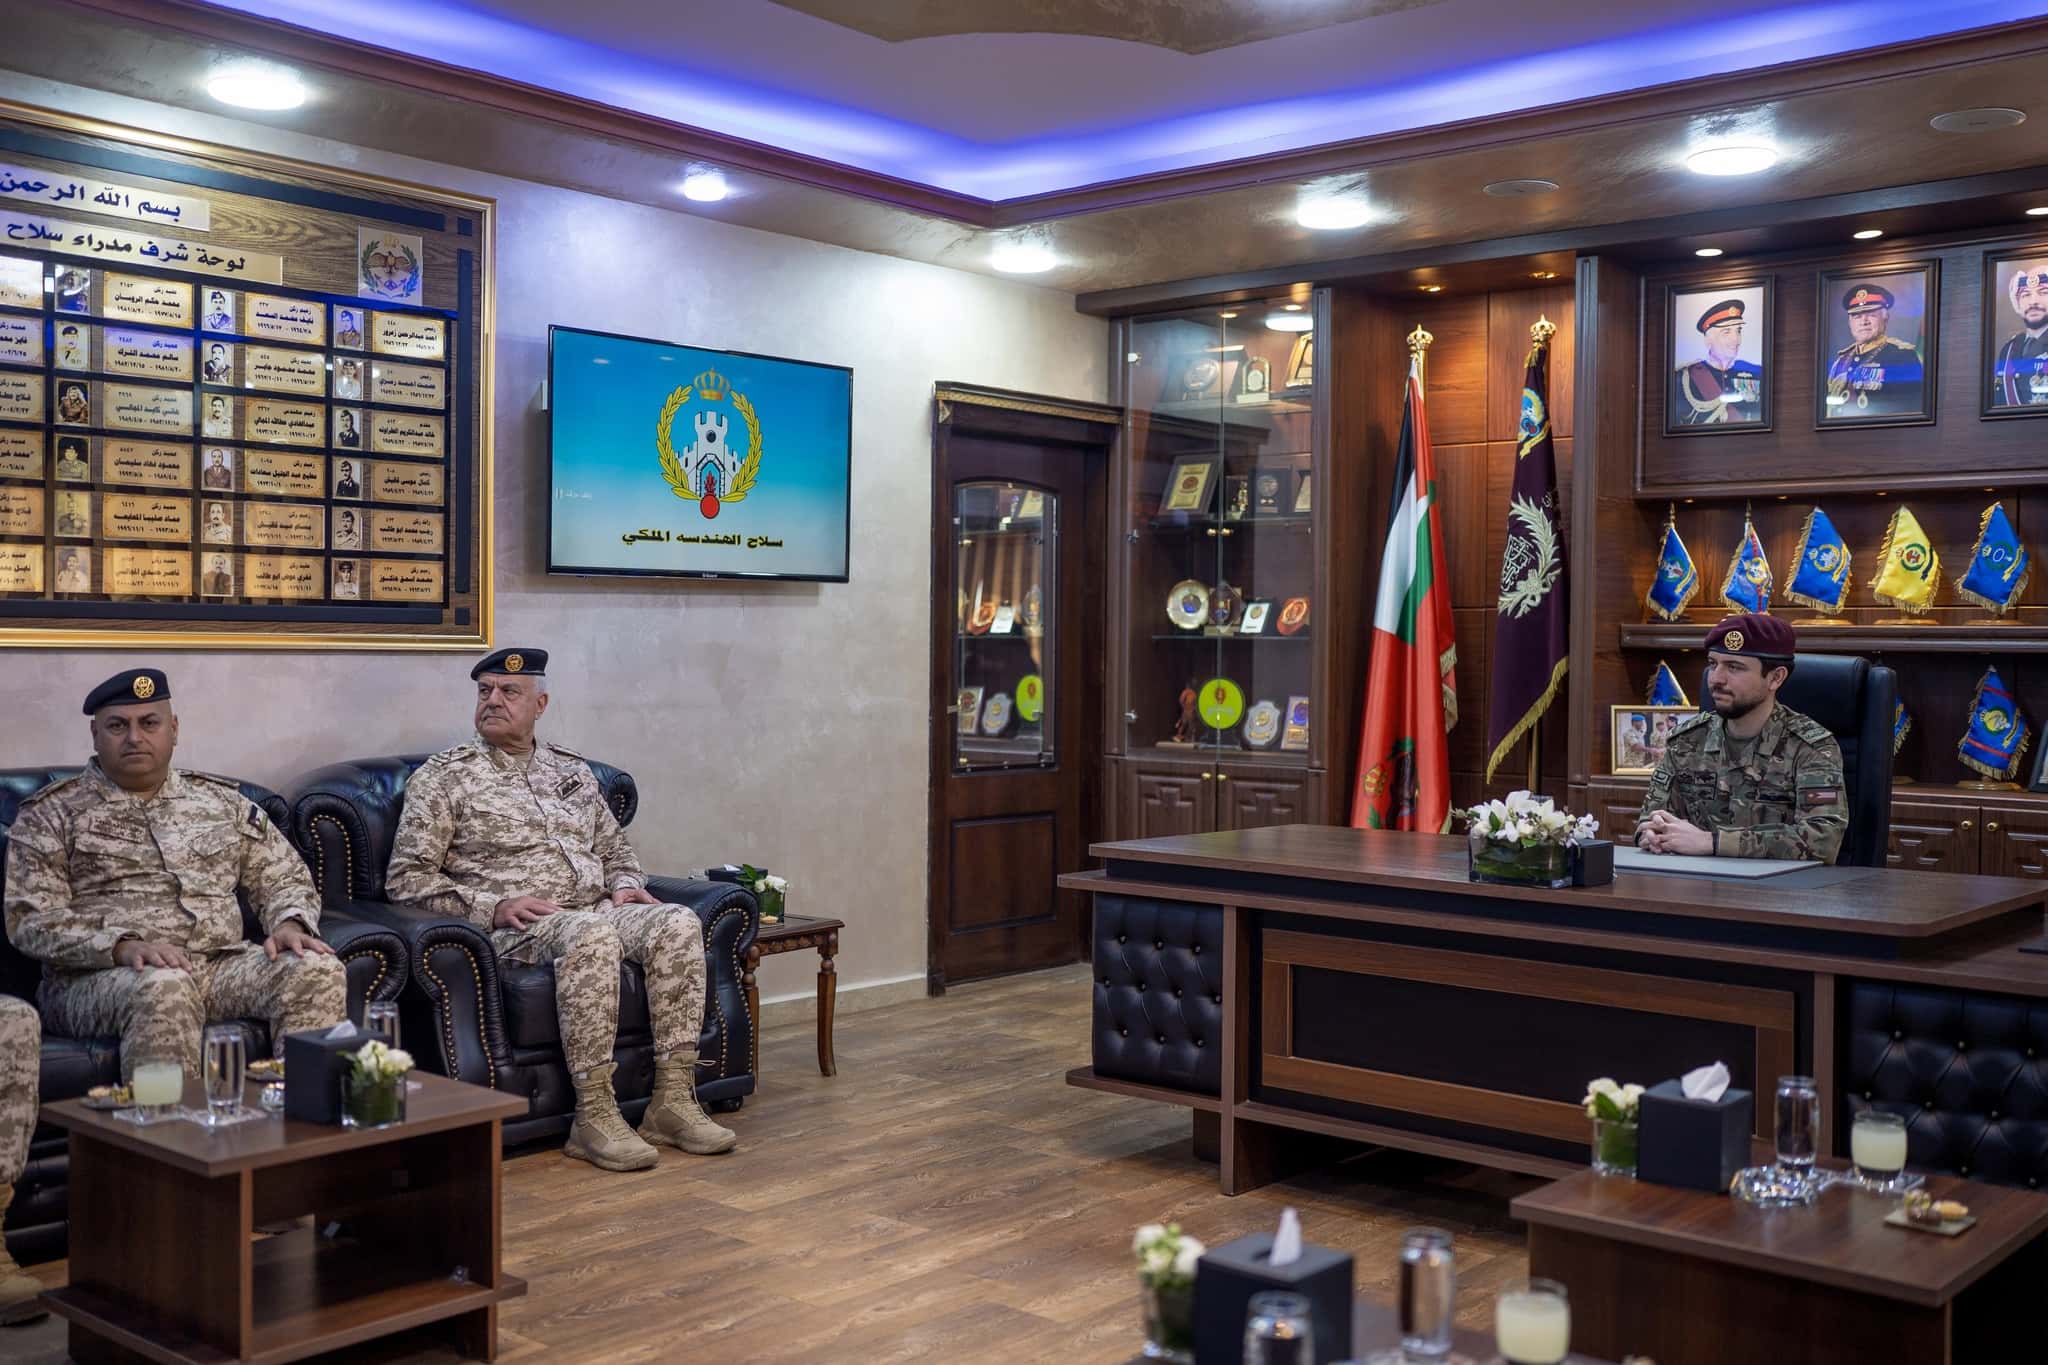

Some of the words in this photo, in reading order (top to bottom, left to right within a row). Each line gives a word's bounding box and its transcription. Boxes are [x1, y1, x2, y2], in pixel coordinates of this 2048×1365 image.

[0, 172, 85, 201] الرحمن
[94, 187, 129, 206] الله
[138, 200, 181, 222] بسم
[7, 224, 63, 242] سلاح
[72, 234, 132, 252] مدراء
[139, 241, 188, 261] شرف
[196, 248, 245, 271] لوحة
[161, 299, 180, 307] محمد
[622, 529, 670, 545] الملكي
[676, 533, 741, 546] الهندسه
[747, 536, 783, 549] سلاح
